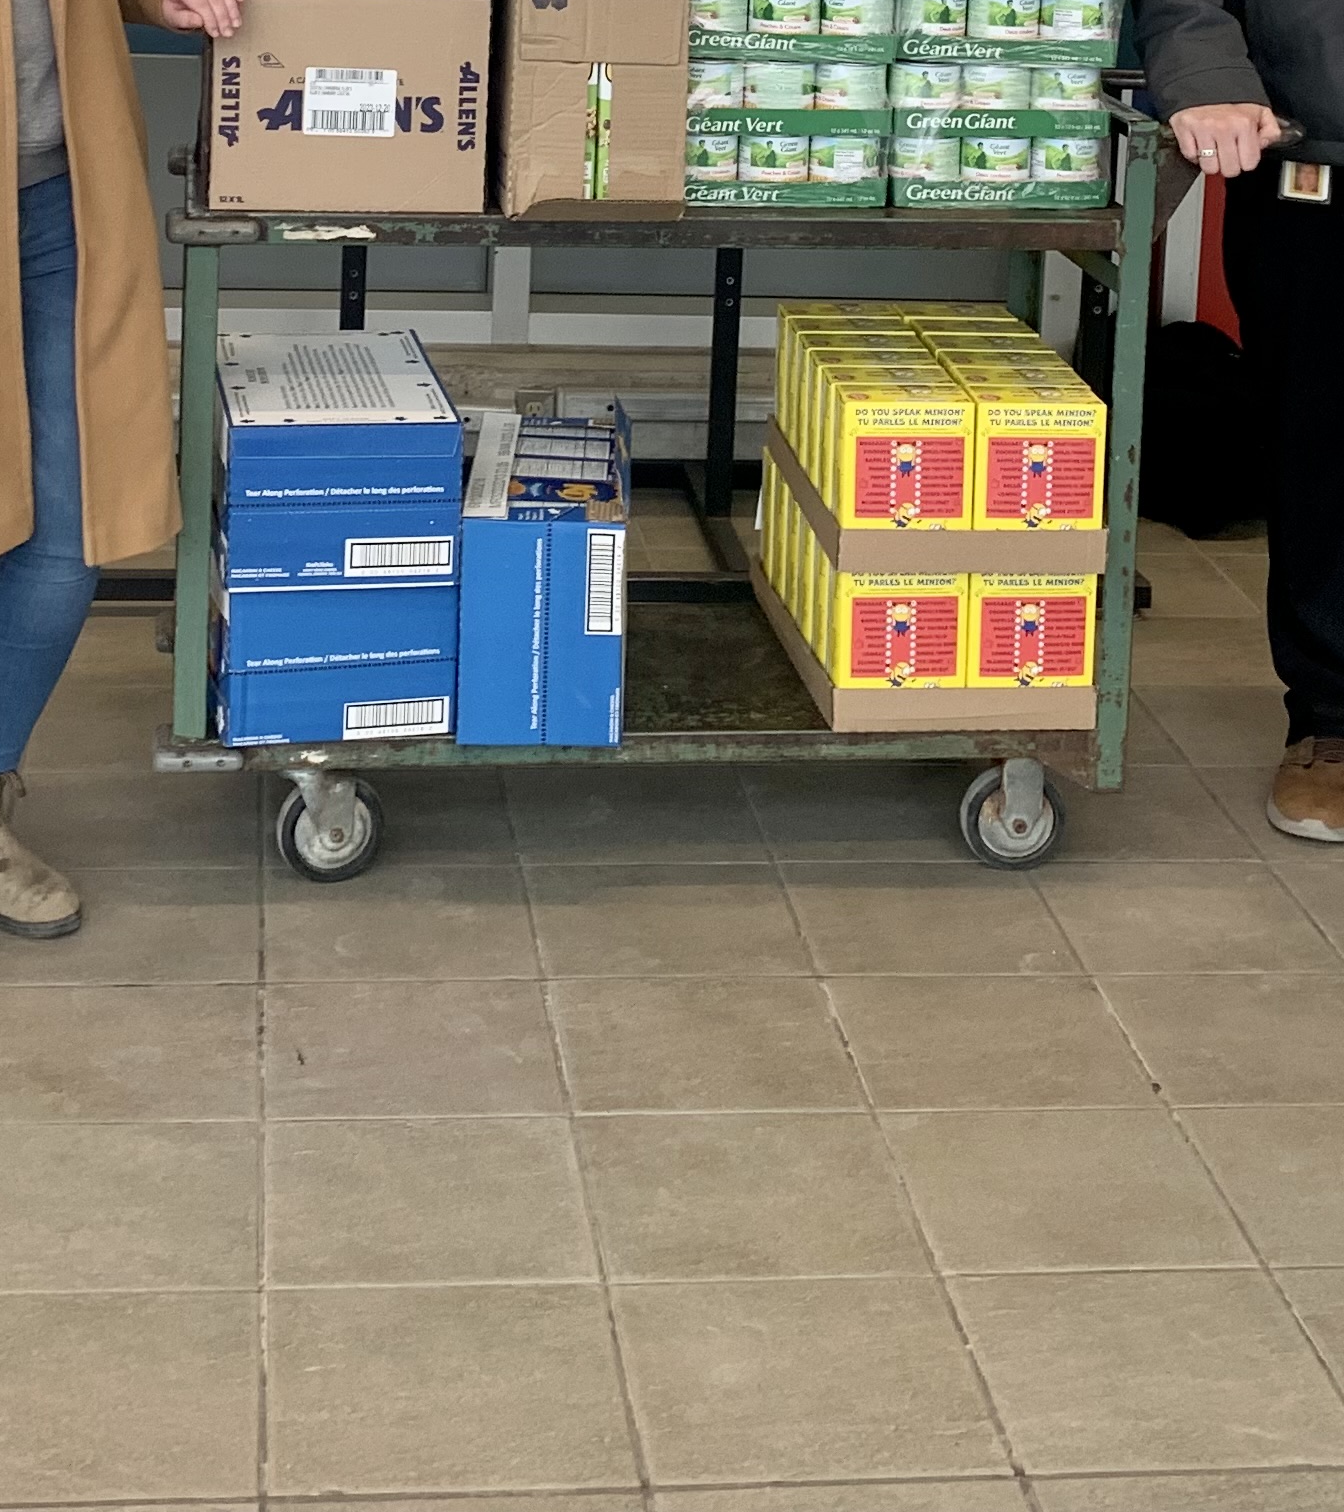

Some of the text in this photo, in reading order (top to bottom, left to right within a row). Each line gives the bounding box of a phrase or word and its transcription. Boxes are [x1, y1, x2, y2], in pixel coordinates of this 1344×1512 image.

[688, 30, 796, 51] Green Giant
[964, 43, 1002, 59] Vert
[218, 55, 241, 147] ALLEN'S
[457, 61, 480, 152] ALLEN'S
[256, 89, 444, 133] AN'S
[745, 117, 783, 133] Vert
[906, 113, 1015, 129] Green Giant
[906, 185, 1015, 201] Green Giant
[917, 578, 956, 586] MINION?
[1045, 578, 1085, 586] MINION?
